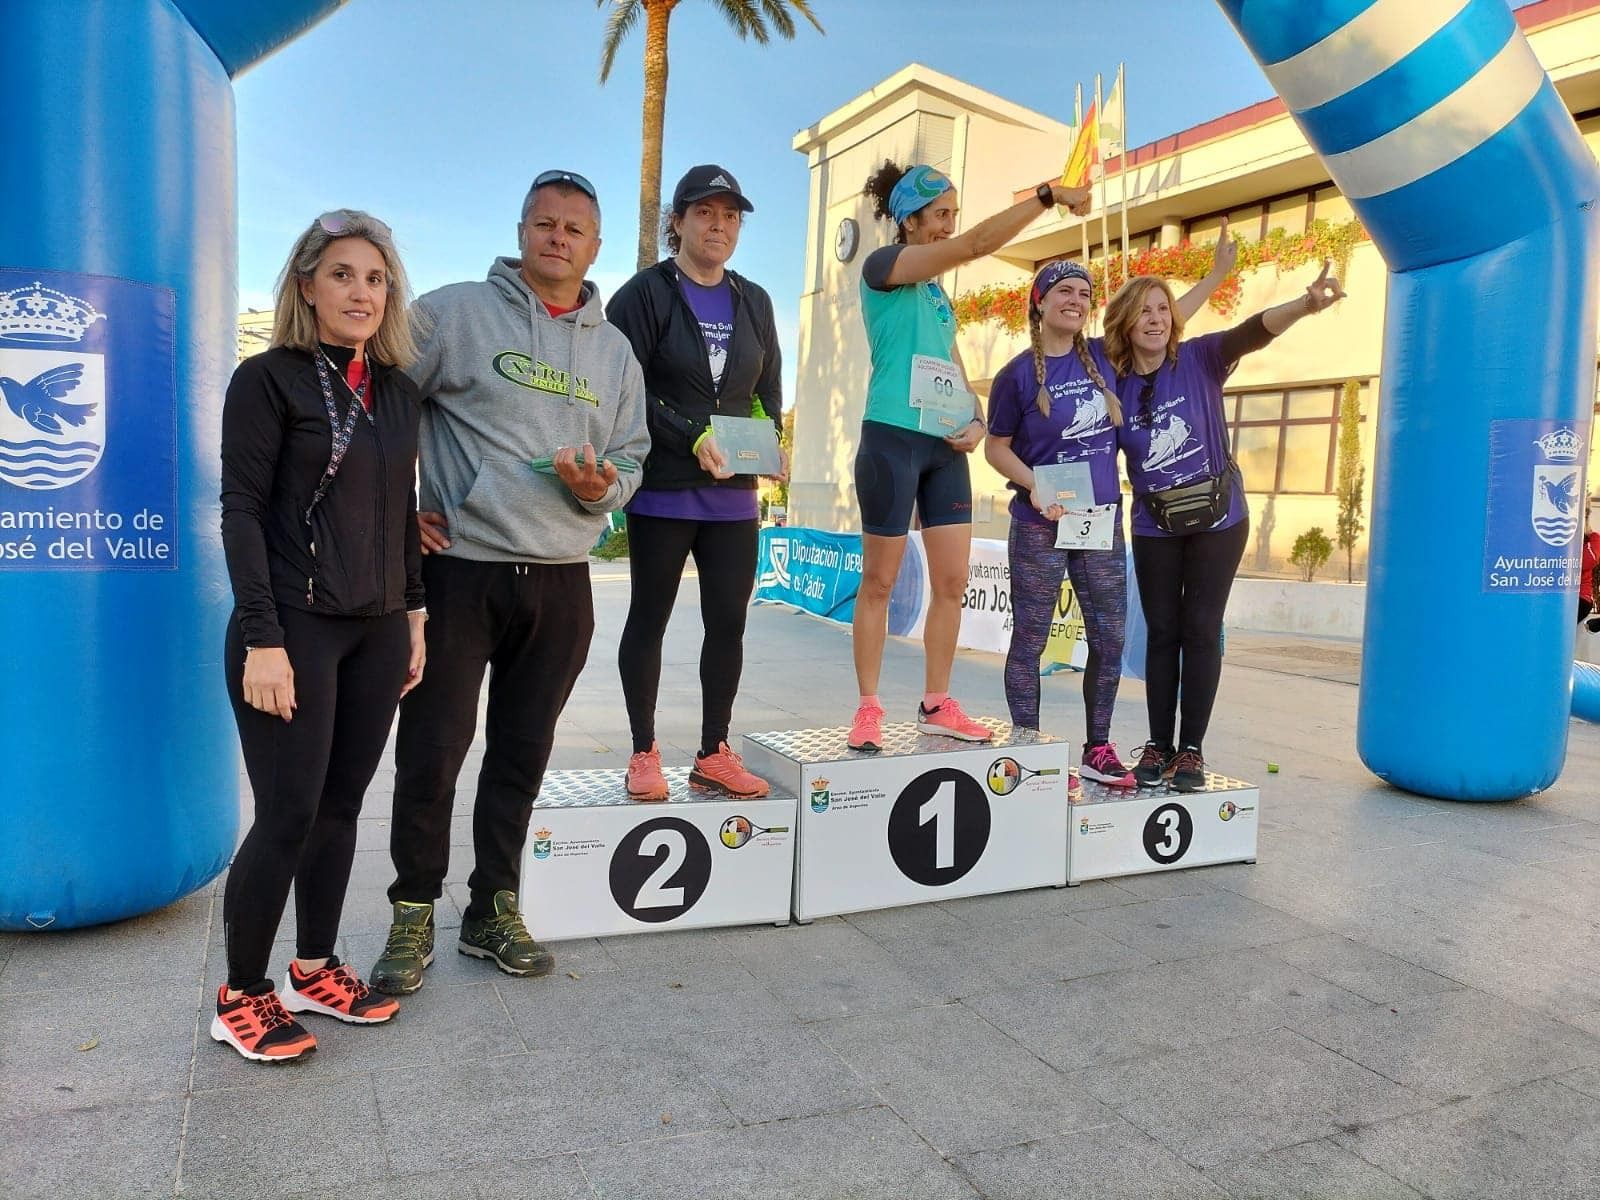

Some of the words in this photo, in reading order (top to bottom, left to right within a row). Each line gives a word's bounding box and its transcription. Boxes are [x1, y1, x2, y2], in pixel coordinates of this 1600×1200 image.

[705, 330, 730, 341] mujer
[934, 376, 954, 397] 60
[0, 505, 123, 530] amiento
[133, 508, 164, 531] de
[1080, 520, 1092, 536] 3
[0, 534, 37, 559] sé
[48, 536, 95, 559] del
[105, 537, 169, 559] Valle
[792, 539, 839, 569] Diputación
[802, 572, 826, 600] Cádiz
[1490, 572, 1519, 587] San
[1524, 571, 1555, 587] José
[1557, 572, 1572, 586] del
[919, 780, 955, 869] 1
[1155, 810, 1180, 857] 3
[633, 828, 687, 909] 2
